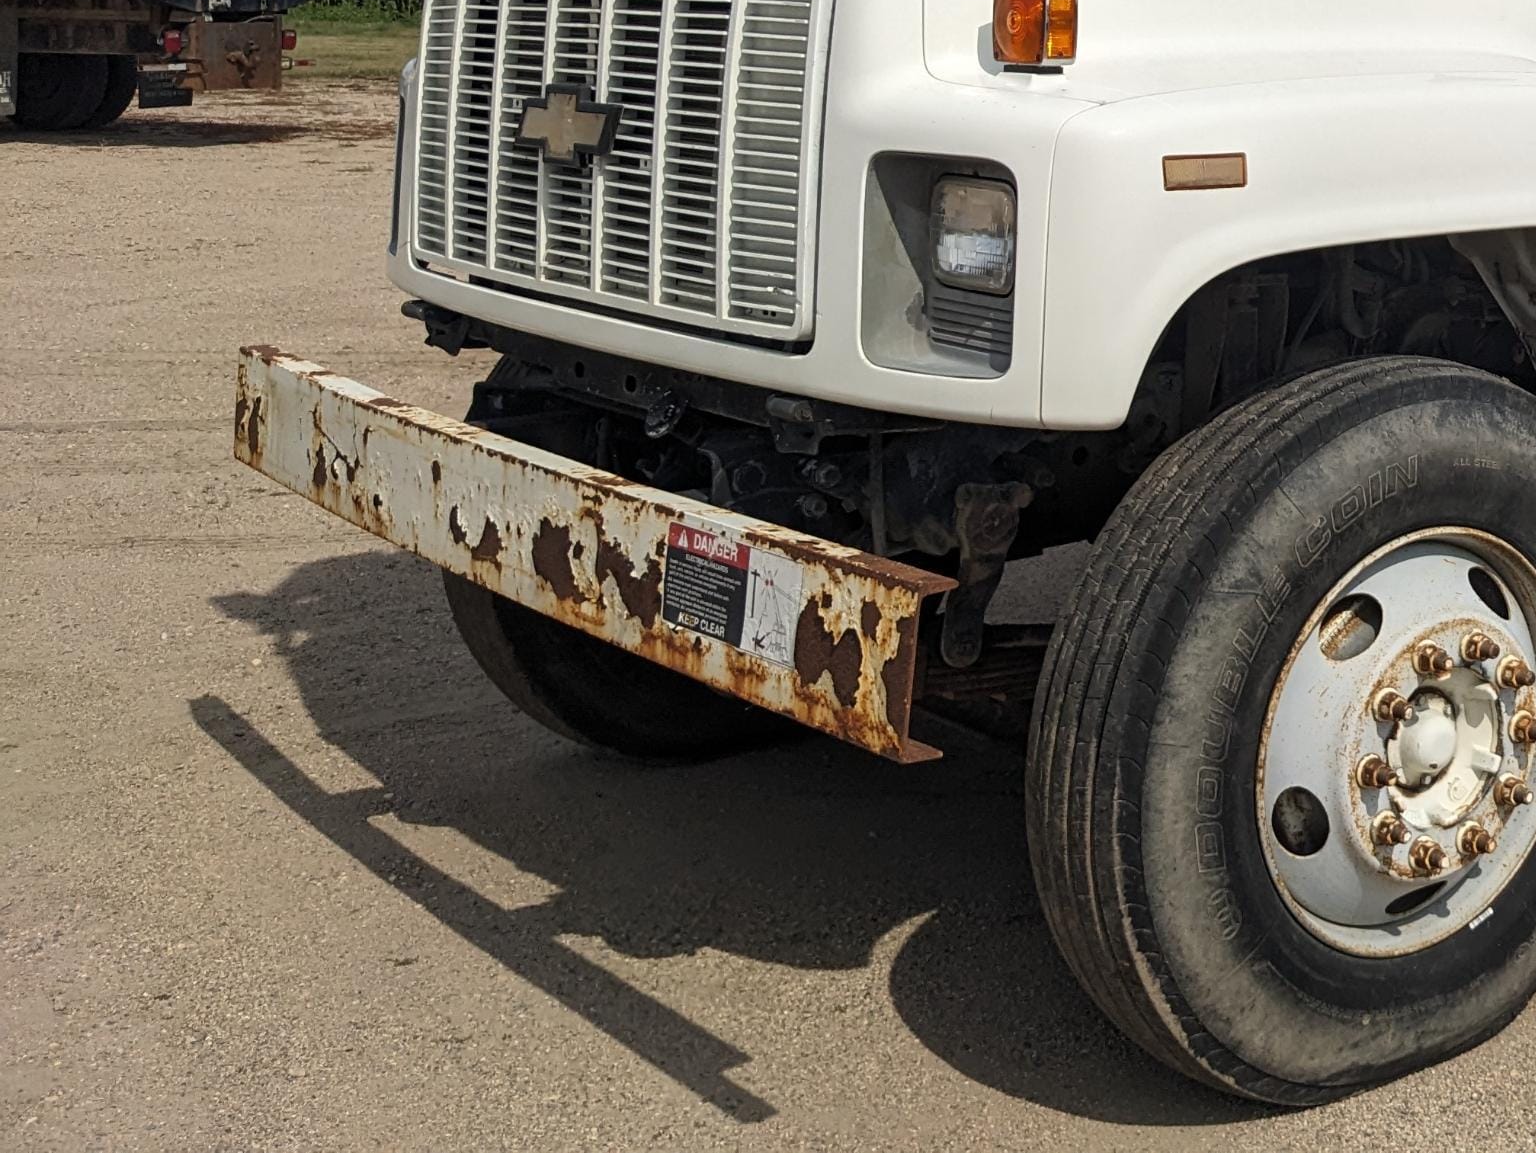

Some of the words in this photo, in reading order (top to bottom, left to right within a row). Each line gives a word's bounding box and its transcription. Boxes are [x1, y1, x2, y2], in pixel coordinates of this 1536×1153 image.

[693, 533, 738, 562] DANGER
[678, 611, 700, 626] KEEP
[700, 619, 725, 638] CLEAR
[1194, 567, 1292, 873] DOUBLE
[1295, 454, 1418, 569] COIN
